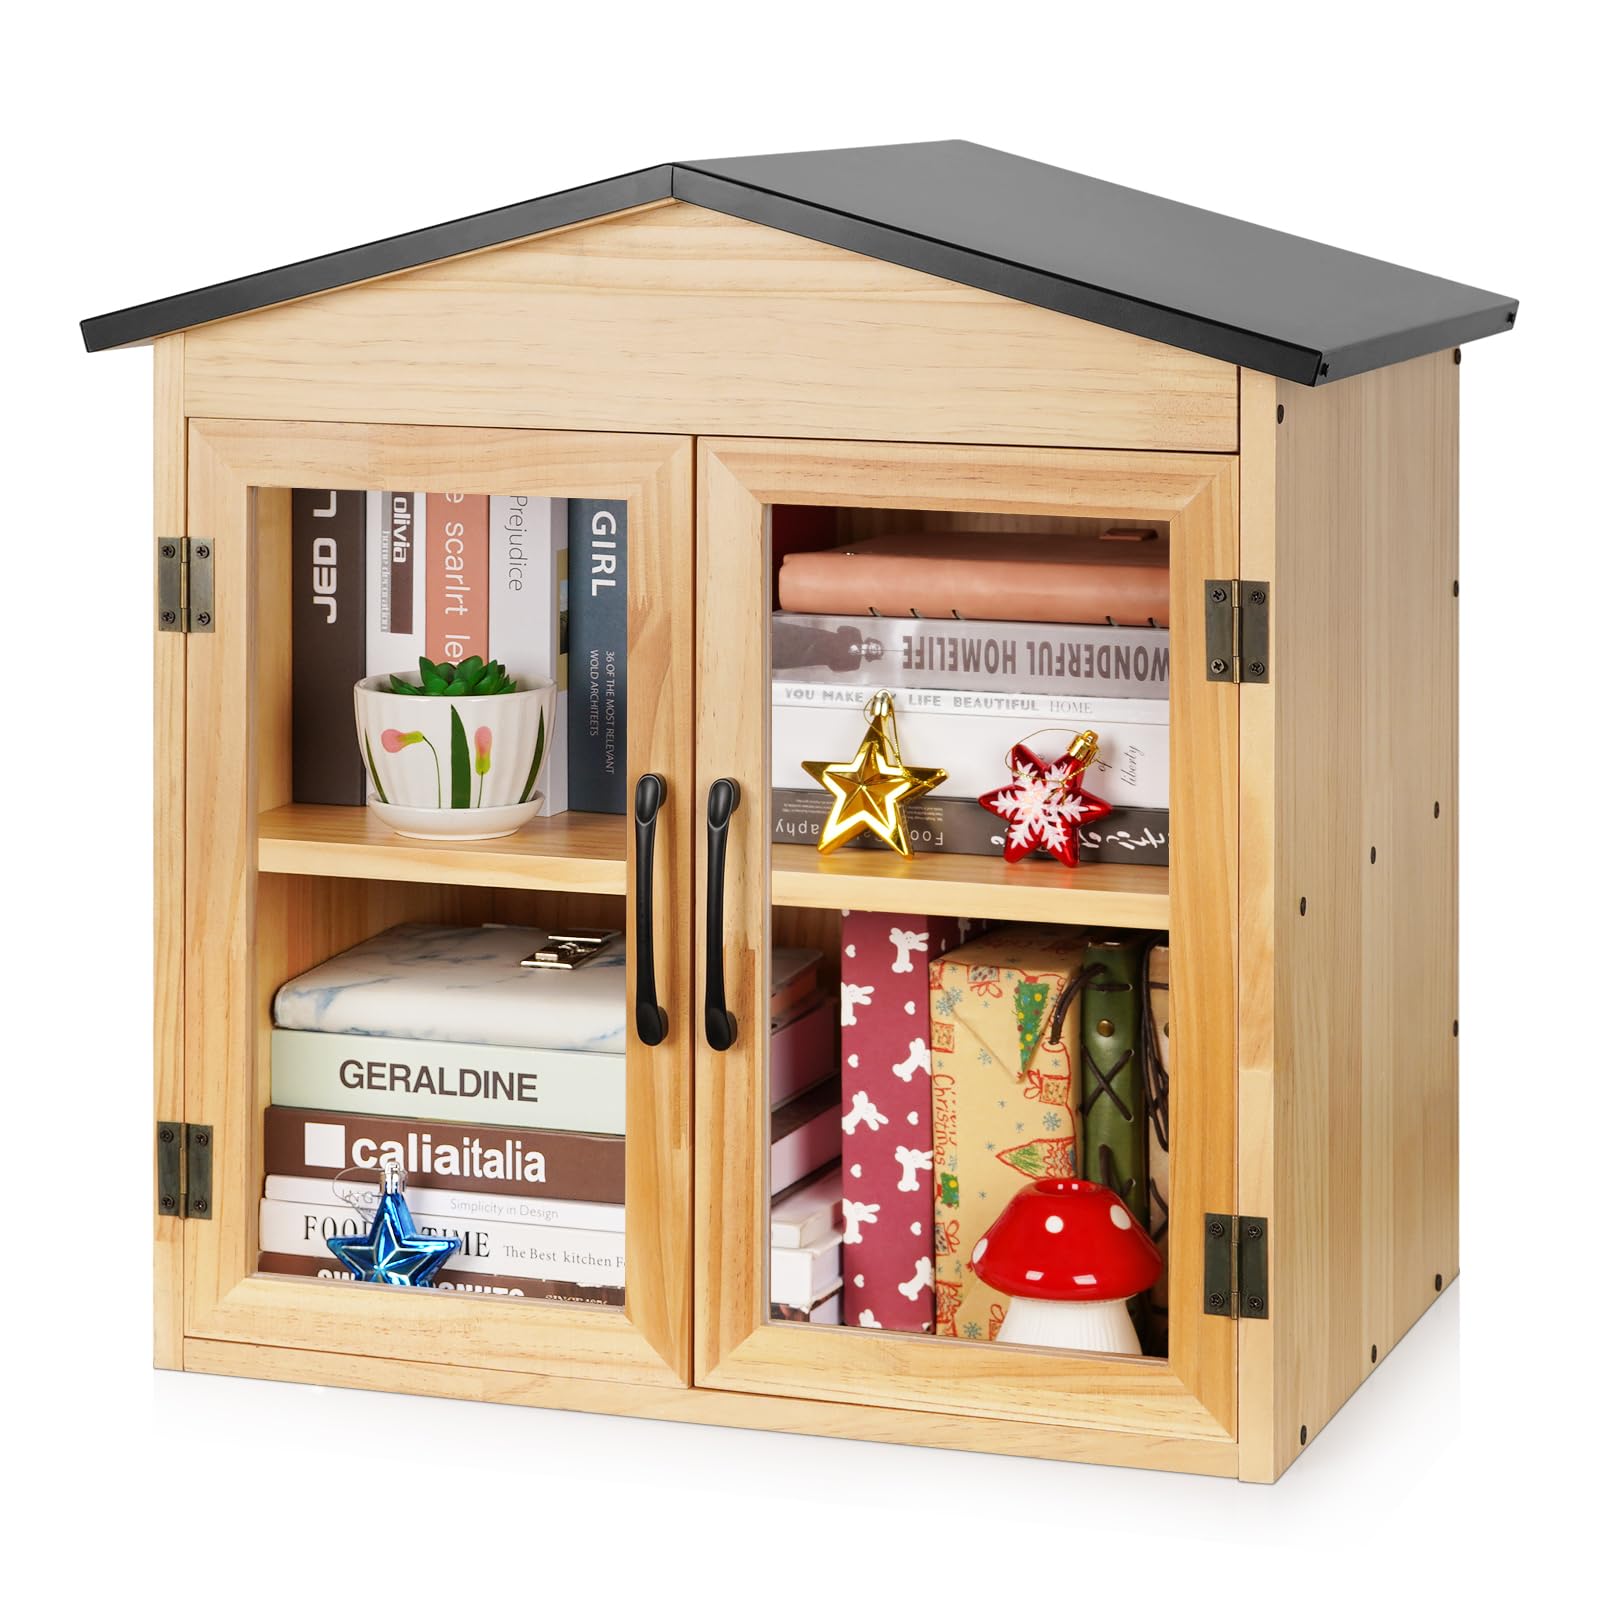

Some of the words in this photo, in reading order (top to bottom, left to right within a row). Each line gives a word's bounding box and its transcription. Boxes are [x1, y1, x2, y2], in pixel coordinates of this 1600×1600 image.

[393, 497, 411, 563] olivia
[504, 495, 528, 592] Prejudice
[444, 521, 471, 616] scarlrt
[591, 510, 617, 597] GIRL
[313, 537, 337, 624] JED
[589, 649, 600, 680] WOLD
[605, 650, 615, 662] 36
[605, 663, 615, 678] OF
[902, 635, 1017, 675] HOMELIFE
[1026, 640, 1169, 682] WONDERFUL
[605, 679, 615, 697] THE
[784, 687, 815, 701] YOU
[822, 690, 864, 704] MAKE
[908, 694, 941, 707] LIFE
[953, 696, 1040, 712] BEAUTIFUL
[1050, 700, 1093, 714] HOME
[605, 699, 615, 726] MOST
[605, 728, 615, 775] RELEVANT
[1120, 745, 1144, 787] liberty
[339, 1059, 538, 1102] GERALDINE
[934, 1073, 956, 1166] Christmas
[351, 1132, 547, 1183] caliaitalia
[304, 1214, 369, 1241] FOO
[450, 1197, 503, 1217] Simplicity
[506, 1204, 517, 1216] in
[519, 1204, 559, 1222] Design
[503, 1244, 527, 1259] The
[530, 1247, 557, 1262] Best
[563, 1250, 612, 1268] kitchen
